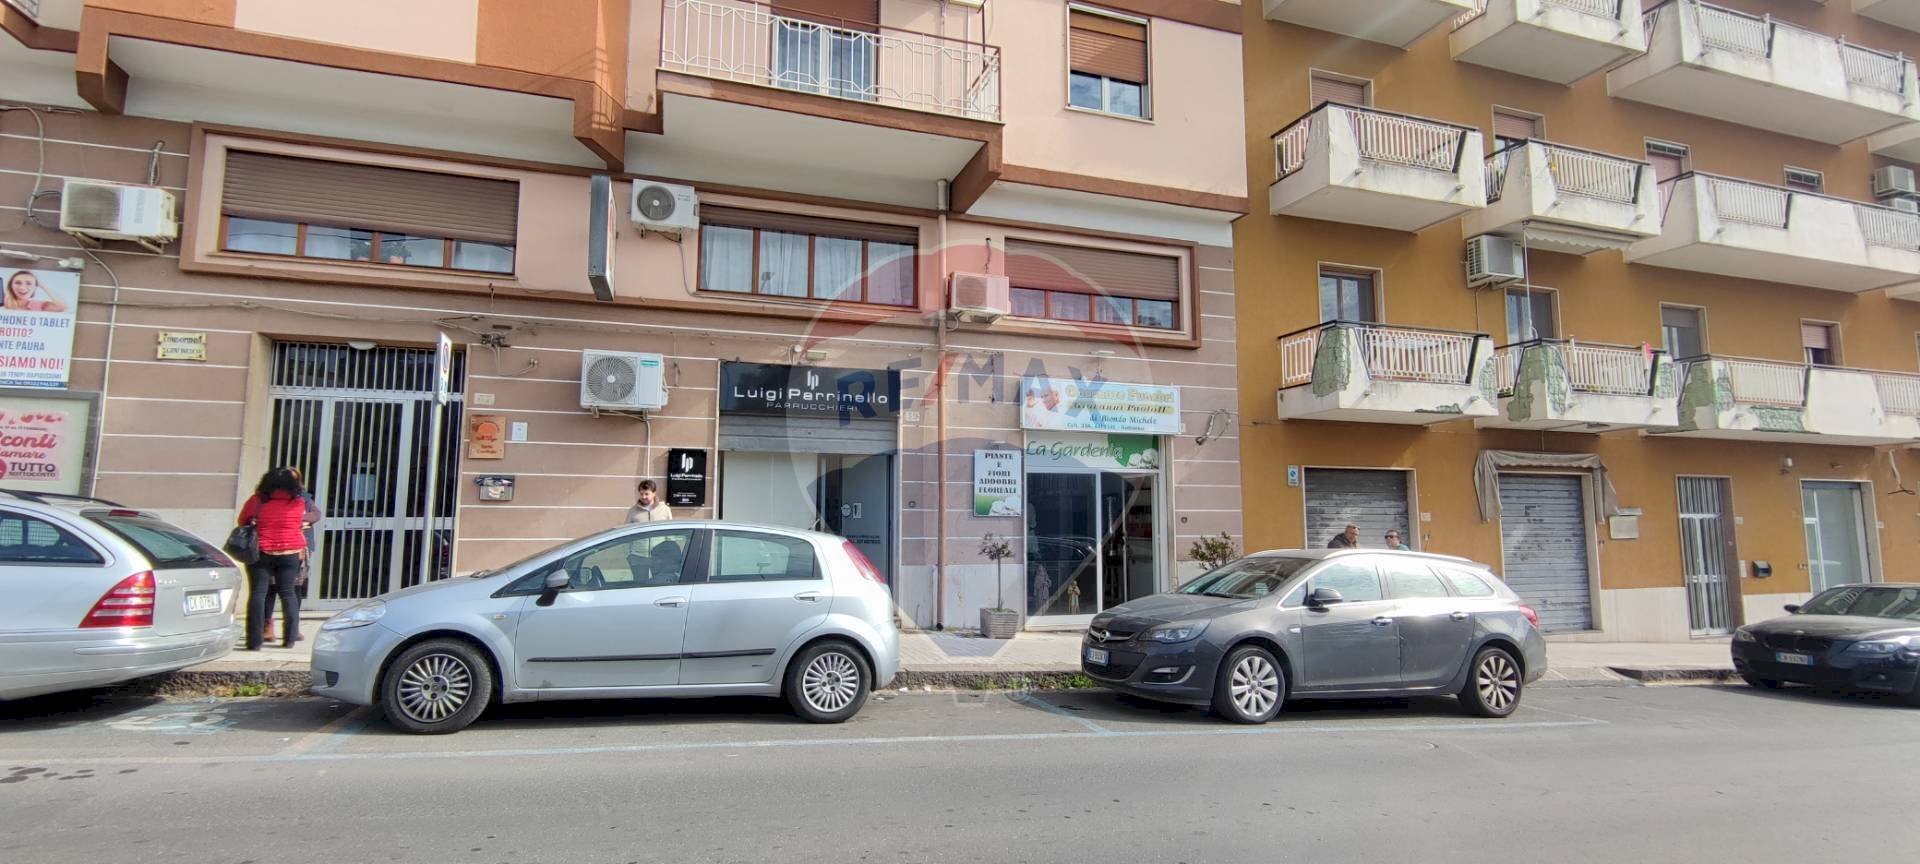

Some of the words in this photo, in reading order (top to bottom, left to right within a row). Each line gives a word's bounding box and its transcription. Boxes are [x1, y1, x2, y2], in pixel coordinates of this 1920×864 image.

[30, 317, 37, 326] O
[39, 317, 71, 328] TABLET
[0, 326, 33, 338] ROTTO?
[15, 340, 45, 351] PAURA
[0, 355, 37, 368] SIAMO
[40, 357, 64, 370] NOI!
[734, 386, 783, 401] Luigi
[788, 388, 888, 404] Parrinello
[766, 402, 858, 412] PARRUCCHIERI
[1130, 416, 1157, 425] Michele
[0, 431, 57, 449] conti
[0, 448, 45, 459] amare
[984, 452, 1014, 460] PIANTE
[1025, 440, 1045, 455] La
[1050, 440, 1124, 461] Gardenia
[9, 462, 55, 473] TUTTO
[978, 486, 1017, 494] FLOREALI
